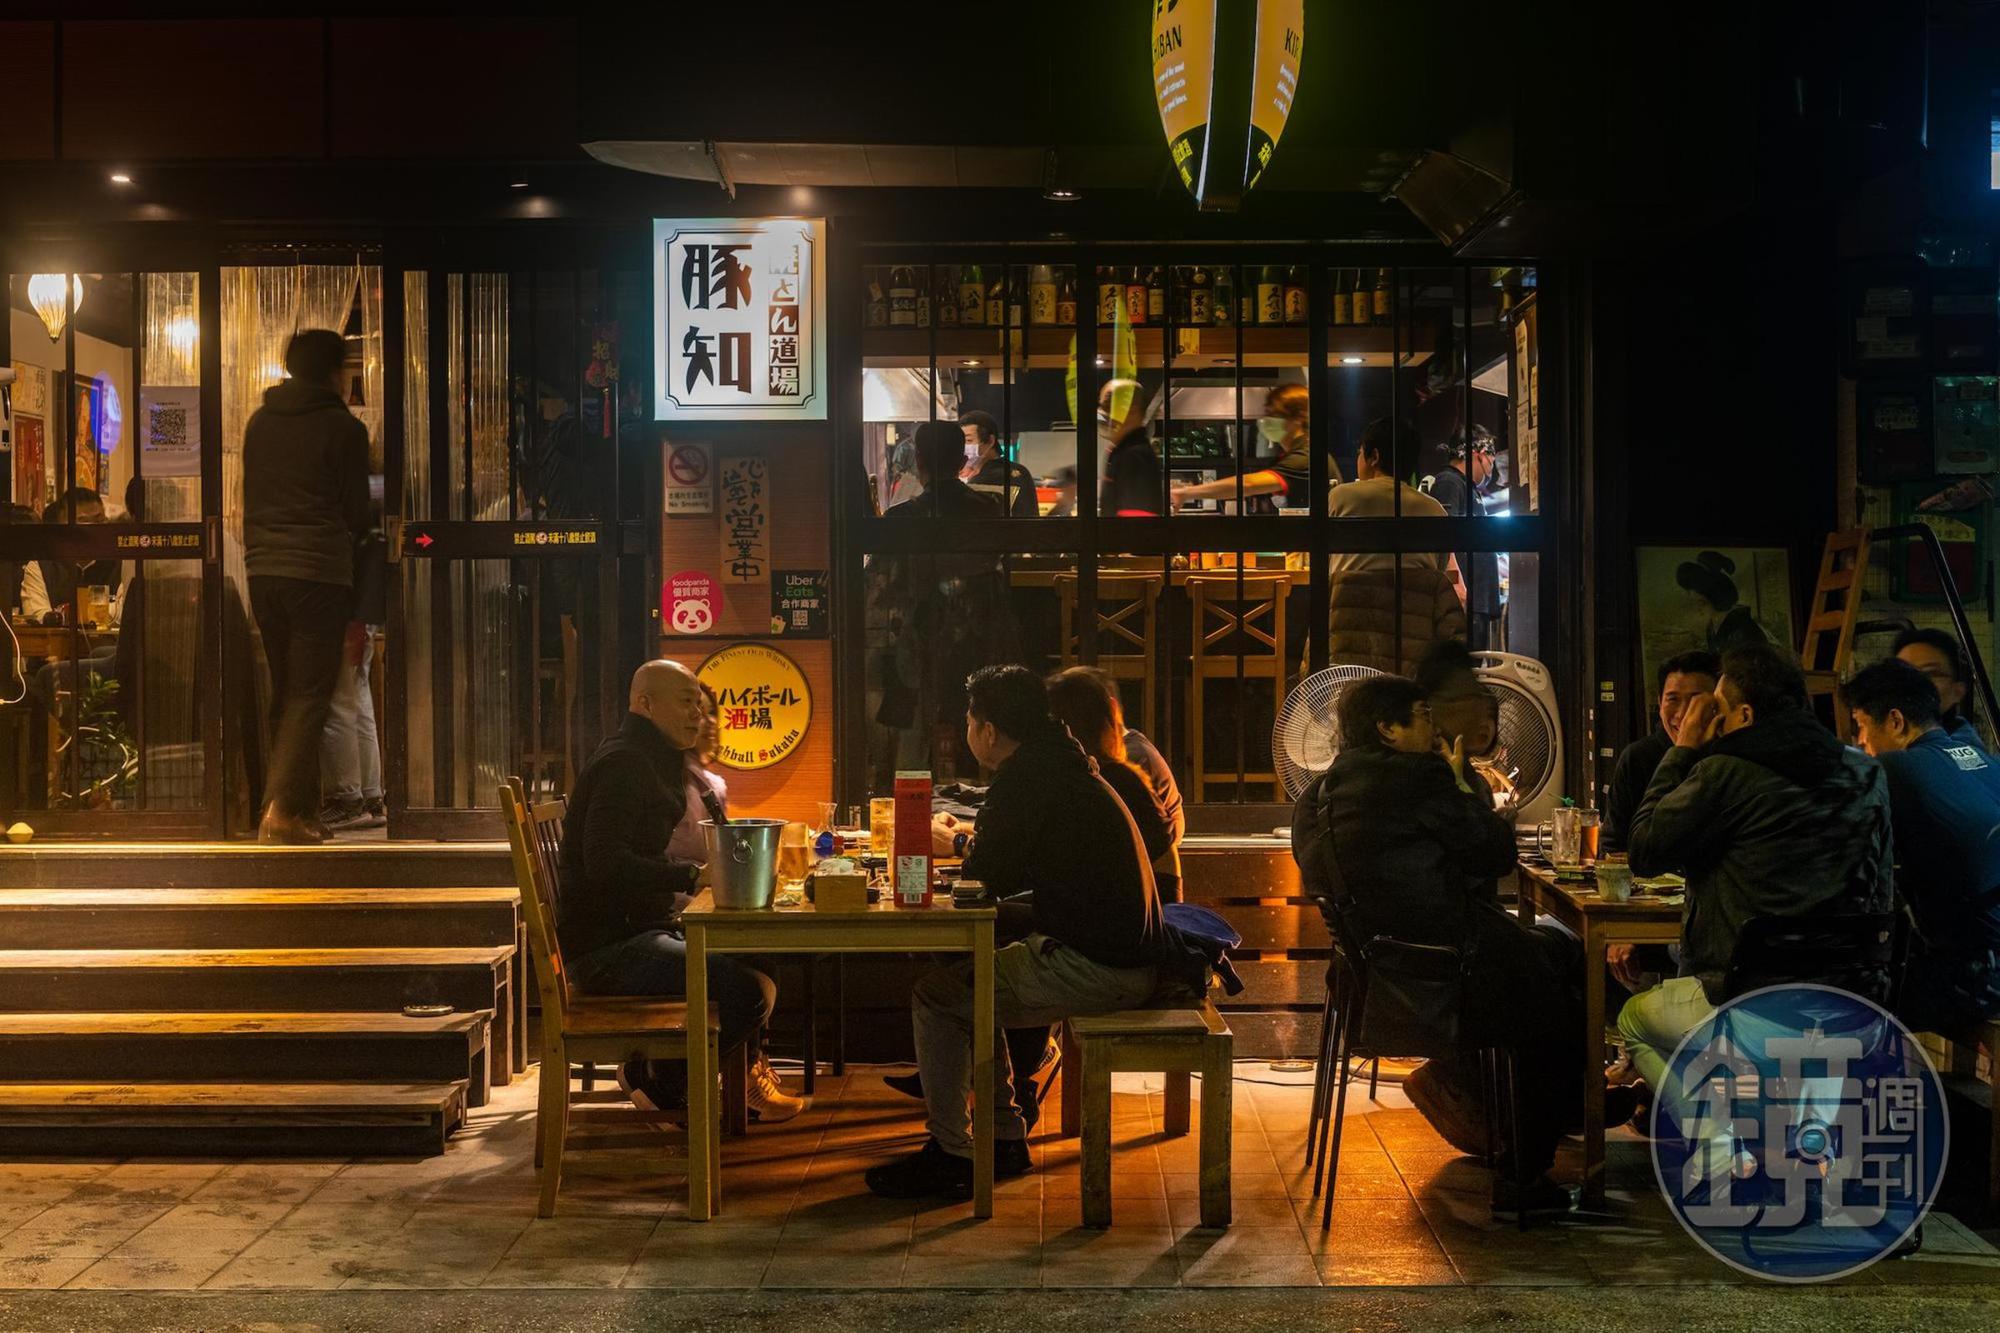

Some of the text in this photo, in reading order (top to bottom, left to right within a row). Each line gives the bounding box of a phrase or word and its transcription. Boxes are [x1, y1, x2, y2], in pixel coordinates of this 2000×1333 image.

[1154, 25, 1182, 60] IBAN
[682, 244, 752, 395] 豚知
[769, 244, 799, 396] とん道場
[672, 578, 710, 587] foodpanda
[785, 575, 814, 586] Uber
[786, 586, 814, 597] Eats
[781, 599, 820, 609] 合作商家
[718, 684, 801, 706] ハイボール
[724, 707, 772, 730] 酒場
[719, 744, 754, 763] hball
